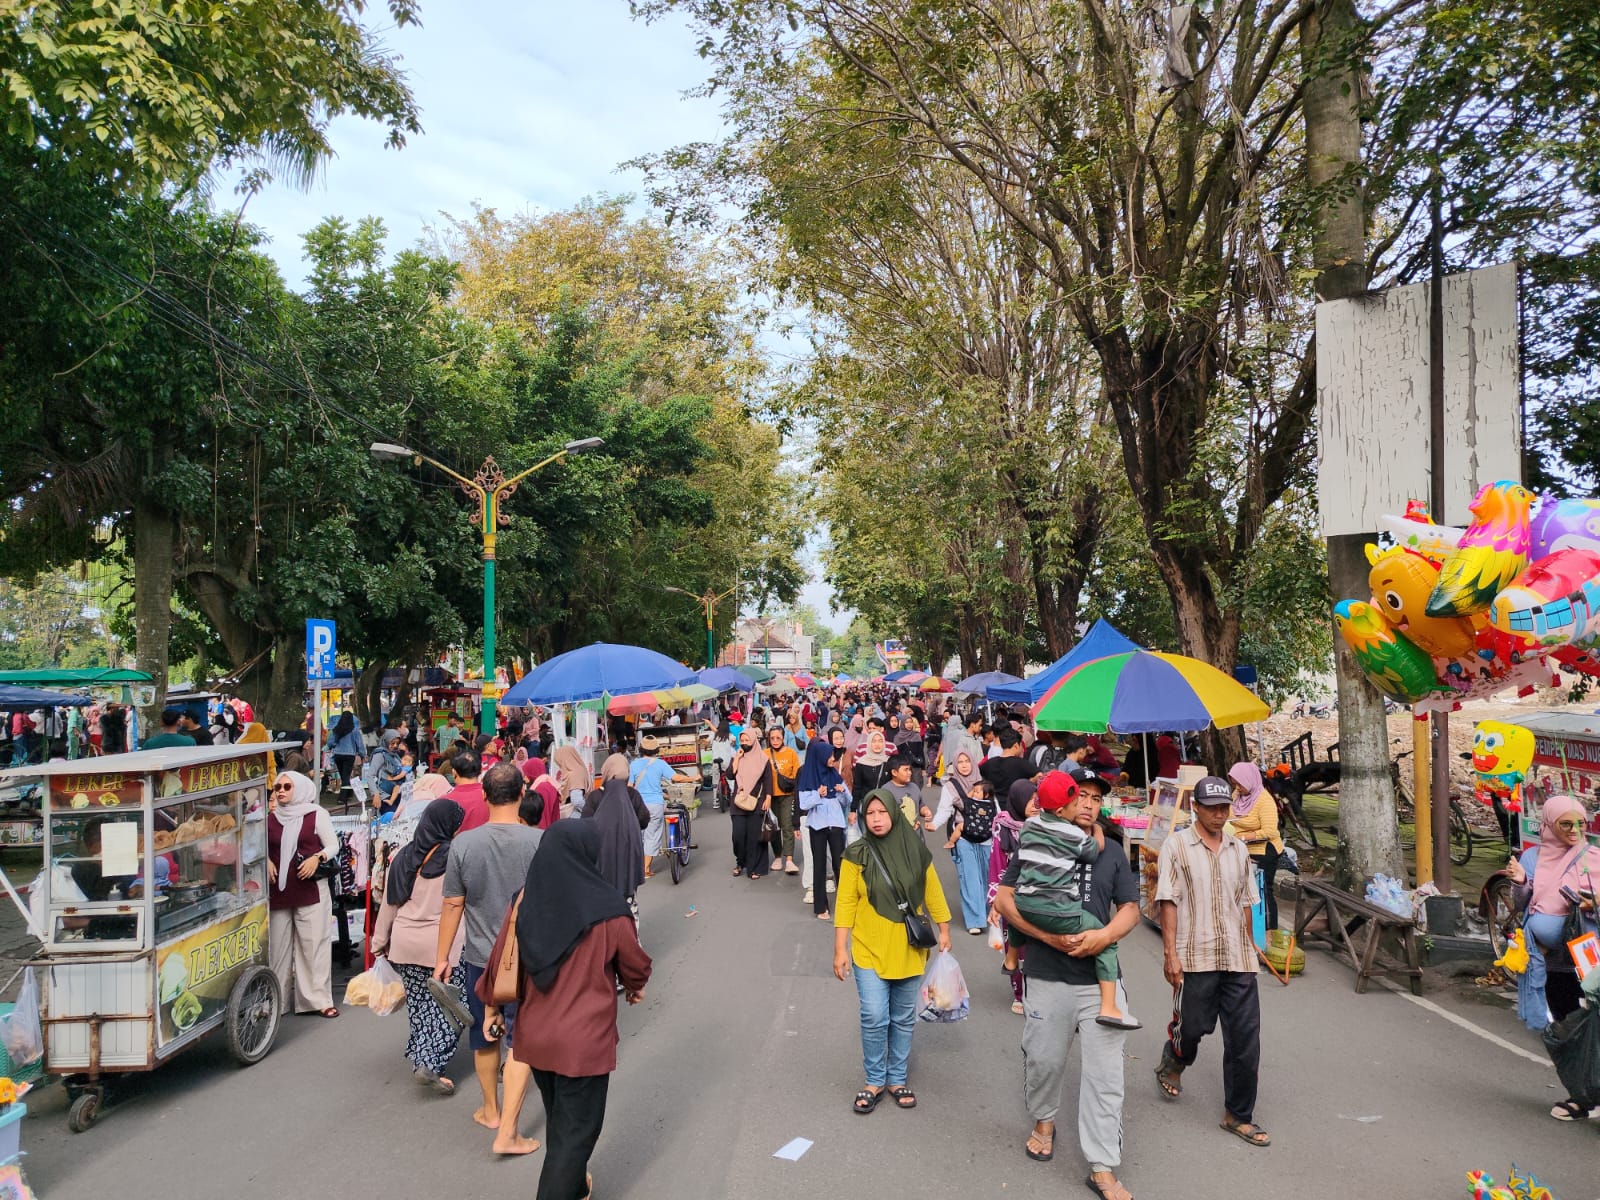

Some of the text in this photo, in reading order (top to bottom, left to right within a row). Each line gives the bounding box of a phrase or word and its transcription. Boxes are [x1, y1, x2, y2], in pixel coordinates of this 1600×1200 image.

[313, 625, 332, 669] P
[1567, 742, 1585, 760] MAS
[64, 774, 125, 792] LEKER
[189, 761, 240, 792] LEKER
[187, 920, 263, 991] LEKER
